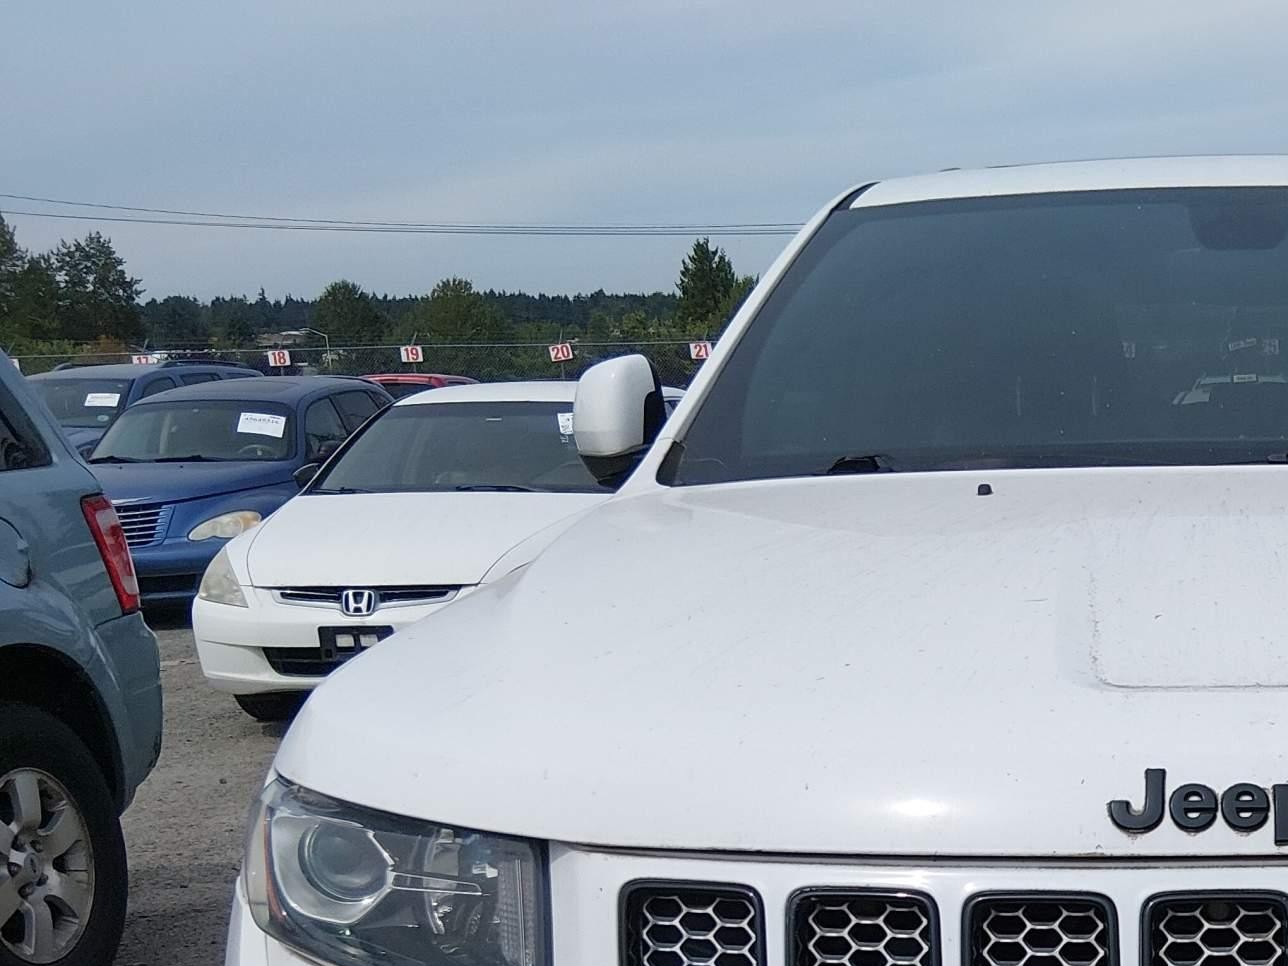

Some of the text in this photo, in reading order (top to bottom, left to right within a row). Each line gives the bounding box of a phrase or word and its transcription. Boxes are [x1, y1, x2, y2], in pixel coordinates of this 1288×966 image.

[272, 351, 287, 364] 18
[404, 347, 420, 361] 19
[551, 344, 571, 360] 20
[694, 343, 710, 358] 21
